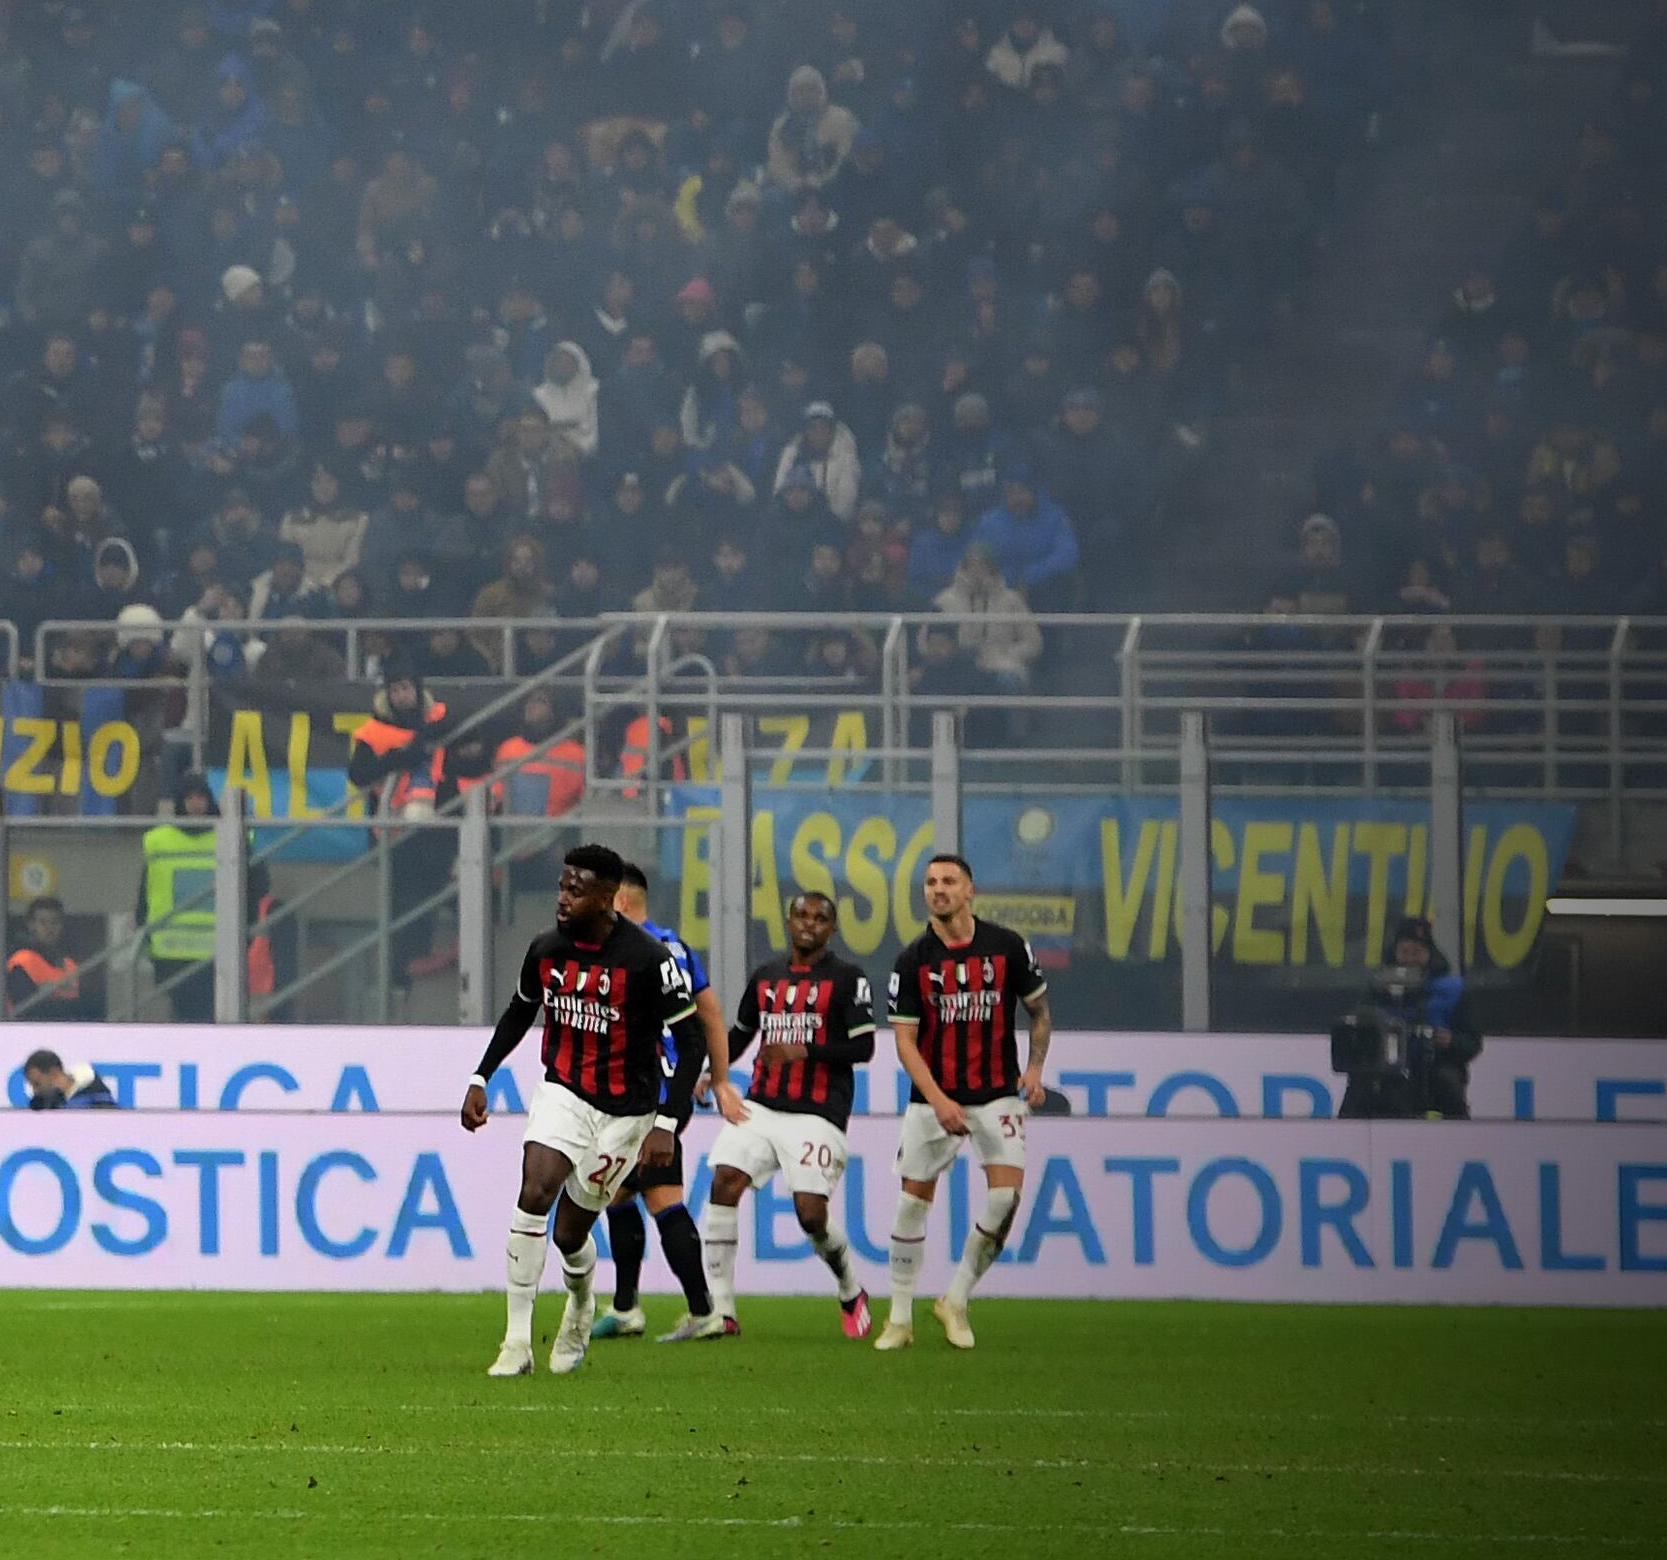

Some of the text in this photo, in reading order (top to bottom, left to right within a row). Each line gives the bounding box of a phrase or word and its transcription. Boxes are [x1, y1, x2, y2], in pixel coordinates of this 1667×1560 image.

[543, 987, 620, 1022] Emirates
[759, 1010, 823, 1031] Emirates
[588, 1154, 627, 1186] 27
[799, 1141, 832, 1169] 20
